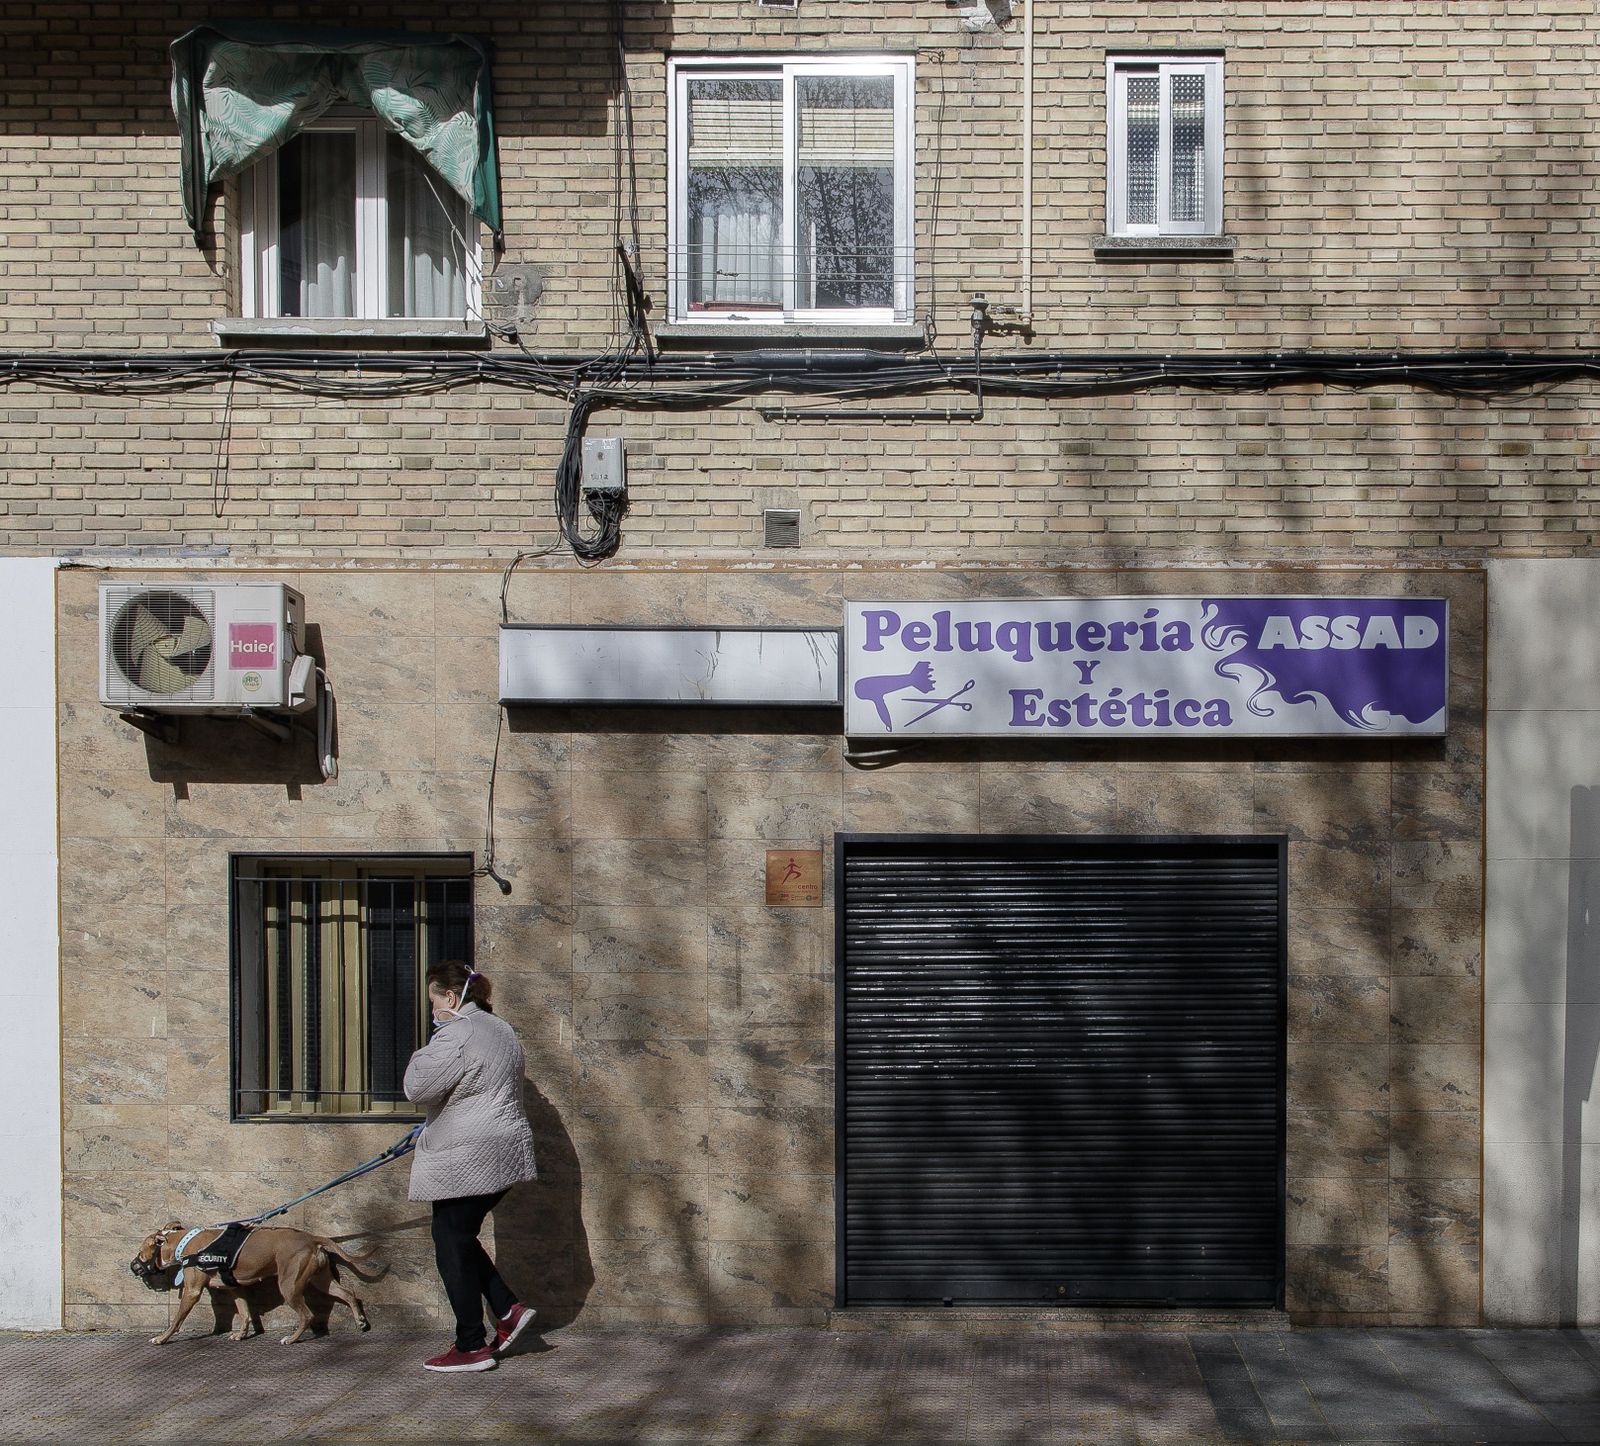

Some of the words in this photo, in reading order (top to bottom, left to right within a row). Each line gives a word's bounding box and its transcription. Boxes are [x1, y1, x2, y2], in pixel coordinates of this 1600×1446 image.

[231, 640, 275, 653] Haier
[861, 608, 1194, 662] Peluquería
[1257, 615, 1439, 650] ASSAD
[1073, 660, 1101, 684] Y
[1008, 687, 1233, 727] Estética
